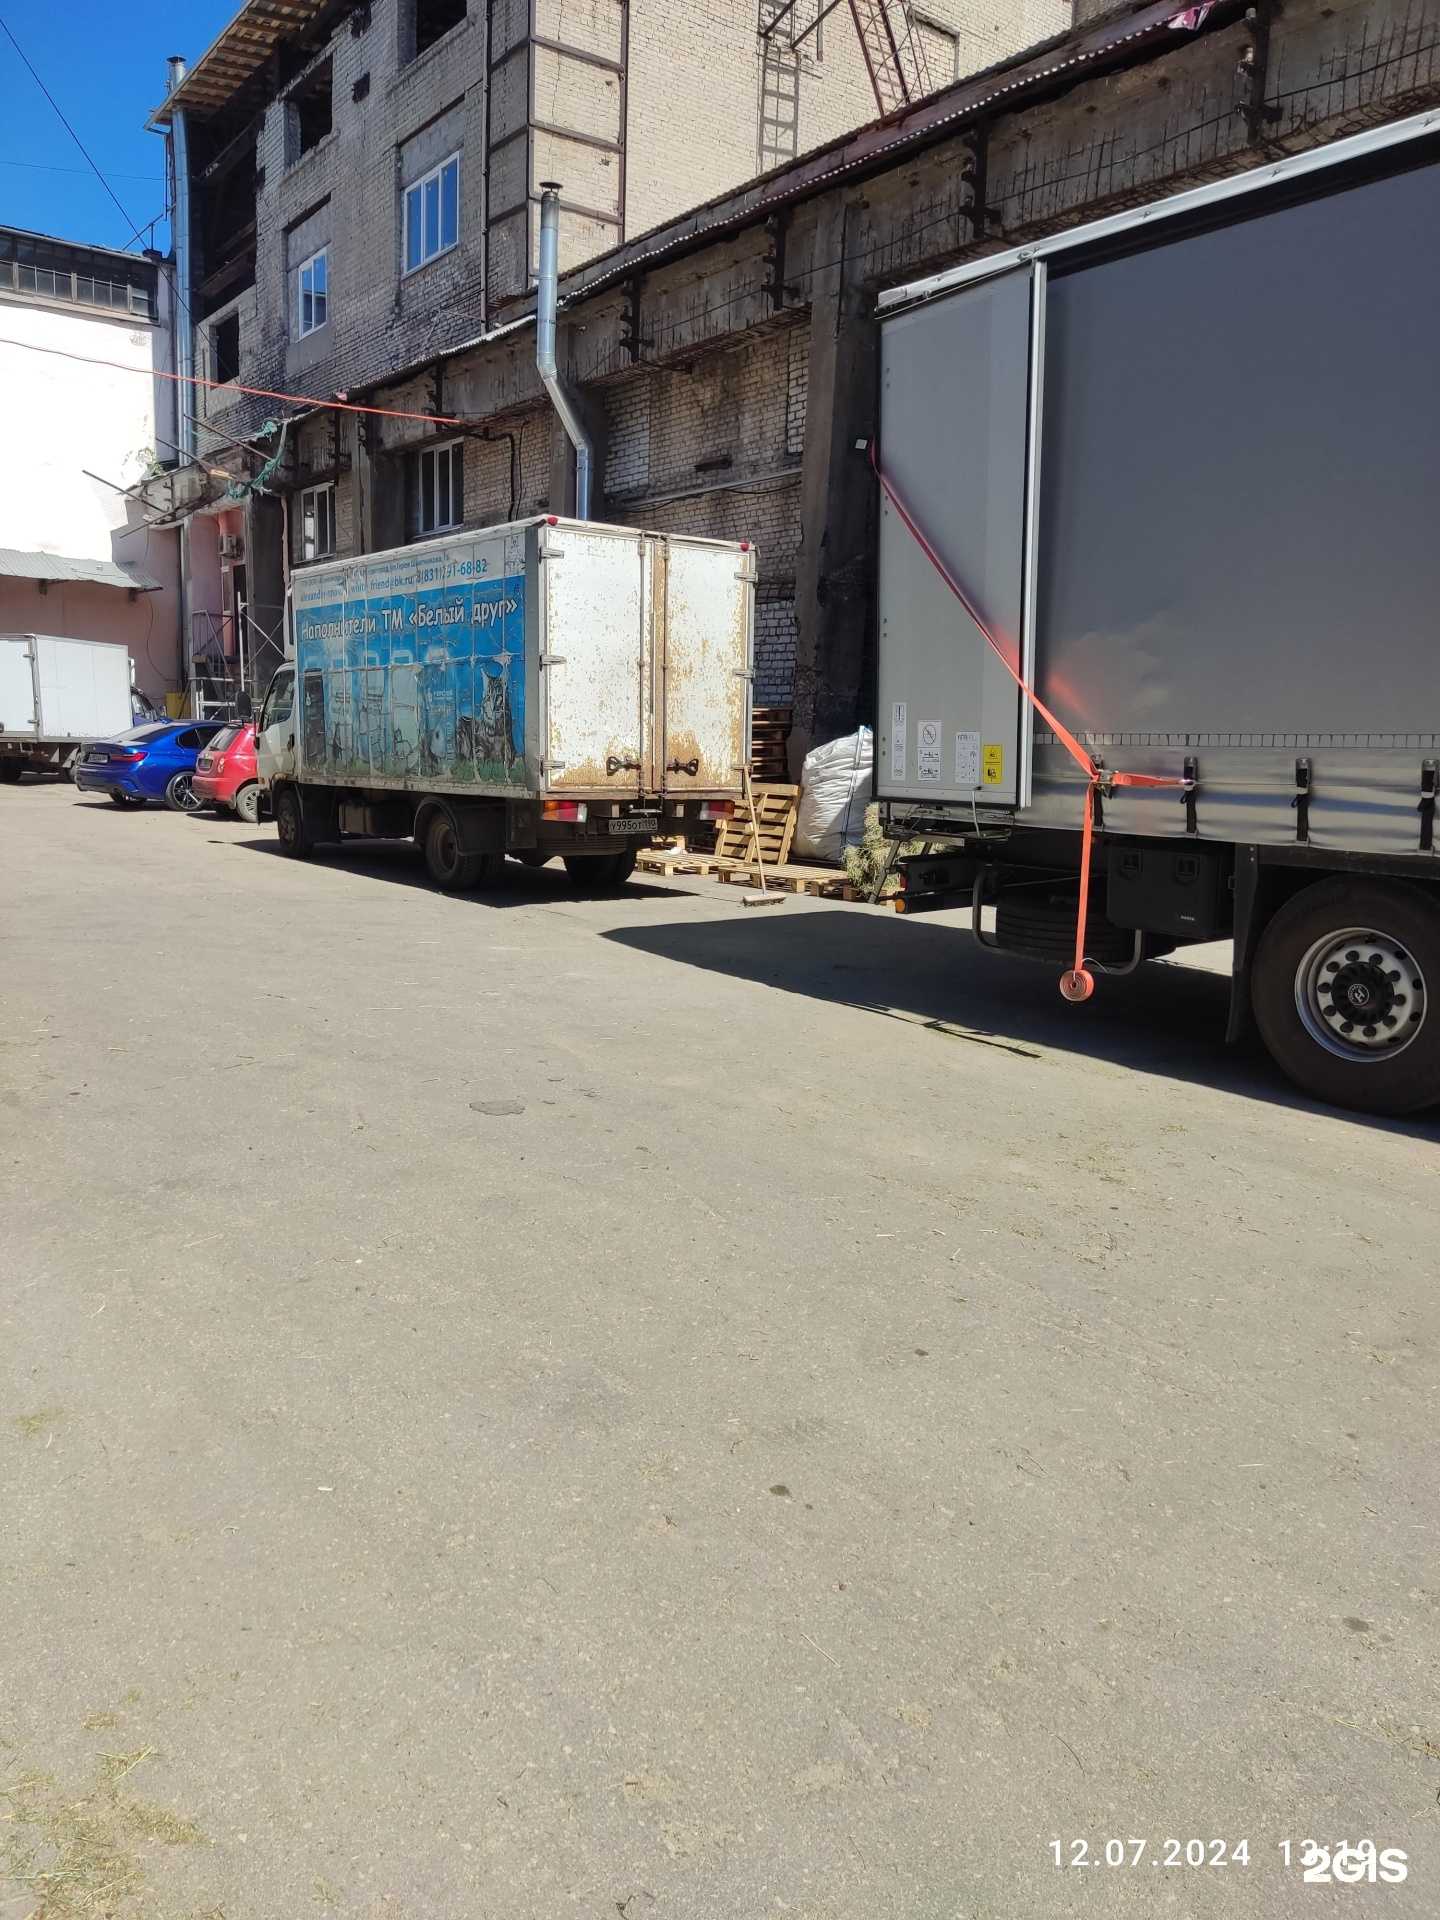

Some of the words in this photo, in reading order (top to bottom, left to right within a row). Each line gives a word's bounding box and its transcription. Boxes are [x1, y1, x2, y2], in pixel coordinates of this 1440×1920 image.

[302, 616, 376, 641] Наполнители
[382, 608, 403, 631] ТМ
[409, 598, 465, 627] «Белый
[471, 600, 518, 627] друг»
